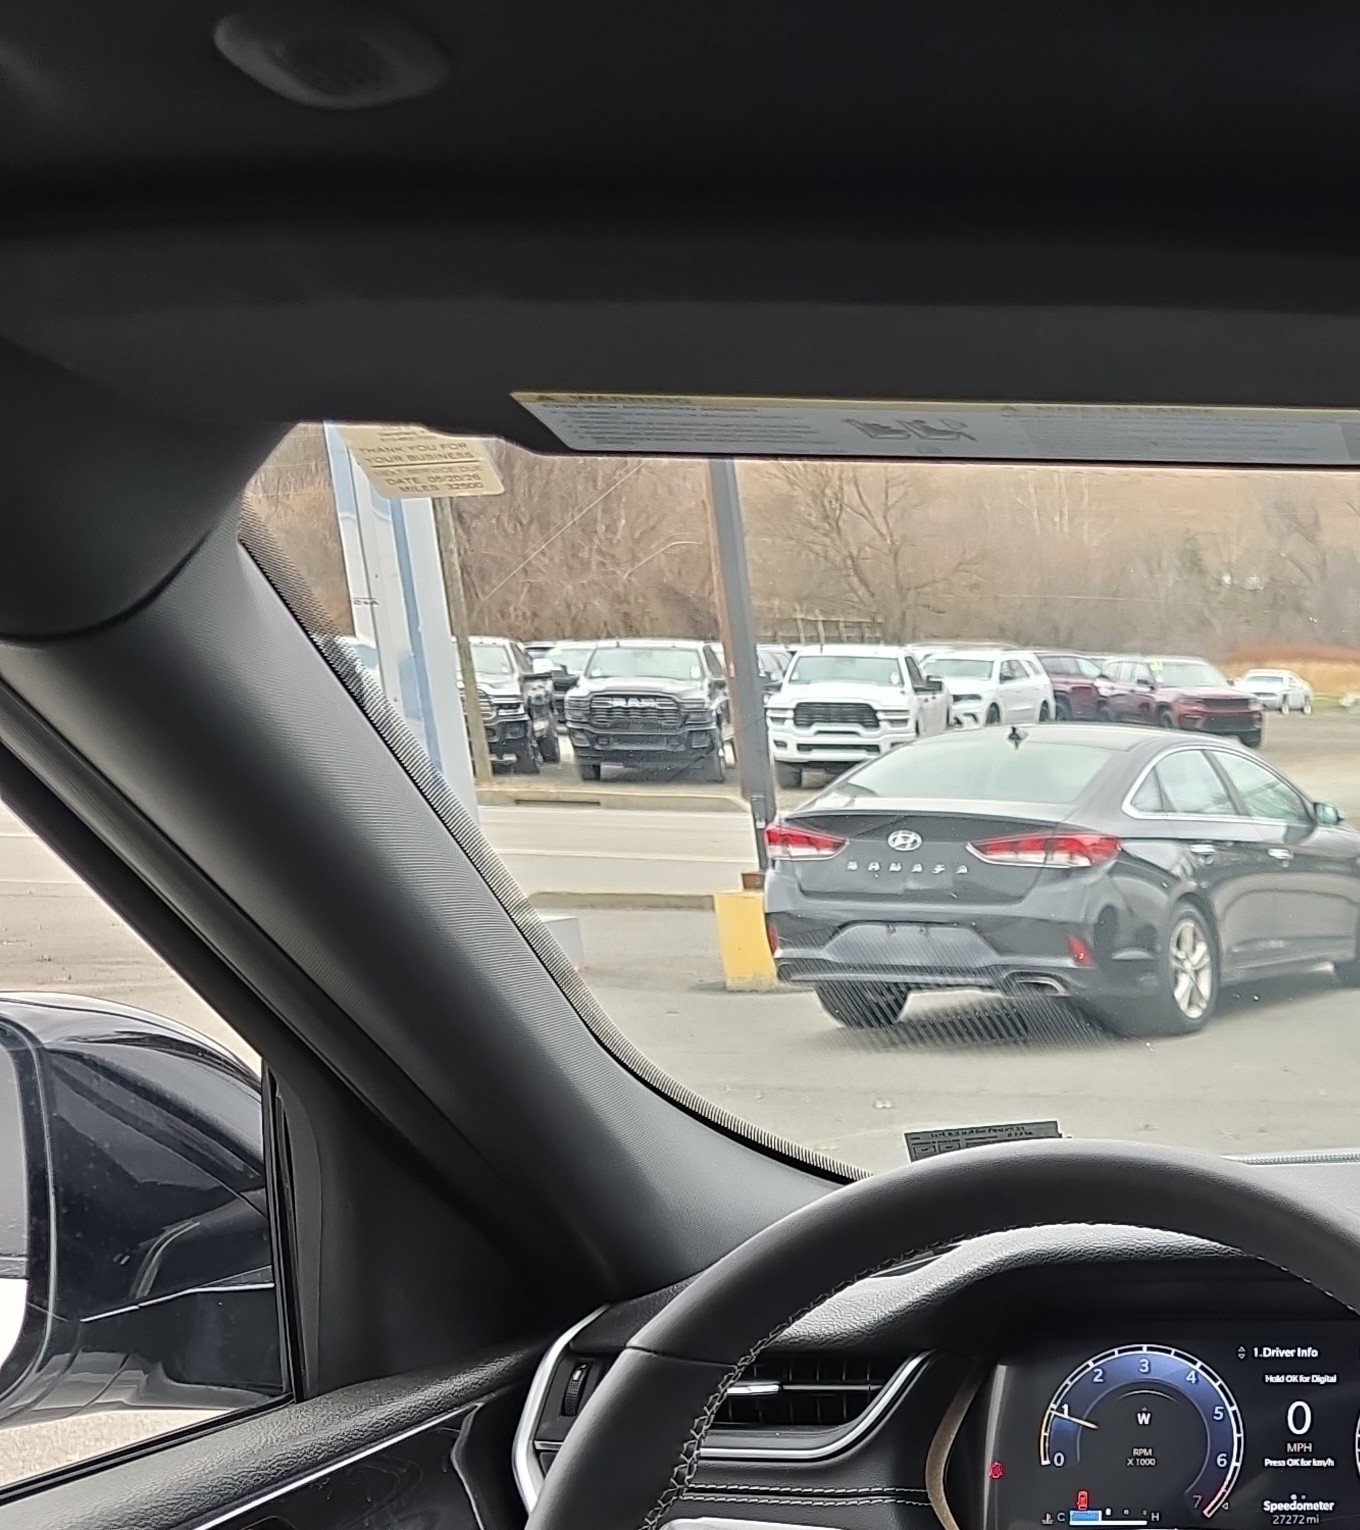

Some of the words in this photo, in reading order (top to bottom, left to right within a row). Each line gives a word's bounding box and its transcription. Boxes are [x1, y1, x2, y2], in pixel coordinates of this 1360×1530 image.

[408, 444, 437, 452] YOU
[440, 442, 467, 450] FOR
[365, 455, 404, 464] YOUR
[408, 452, 474, 461] BUSINESS
[386, 477, 420, 485] DATE
[400, 484, 440, 493] MILES
[1297, 1347, 1318, 1358] Info
[1139, 1359, 1149, 1373] 3
[1093, 1369, 1104, 1383] 2
[1186, 1370, 1198, 1383] 4
[1286, 1374, 1298, 1383] OK
[1214, 1406, 1224, 1420] 5
[1287, 1401, 1312, 1435] 0
[1137, 1413, 1151, 1425] W
[1133, 1448, 1153, 1457] RPM
[1286, 1442, 1312, 1453] MPH
[1054, 1453, 1065, 1467] 0
[1136, 1458, 1155, 1467] 1000
[1217, 1453, 1228, 1467] 6
[1287, 1458, 1300, 1467] OK
[1192, 1495, 1203, 1509] 7
[1263, 1500, 1335, 1513] Speedometer
[1057, 1513, 1065, 1522] C
[1151, 1512, 1160, 1522] H
